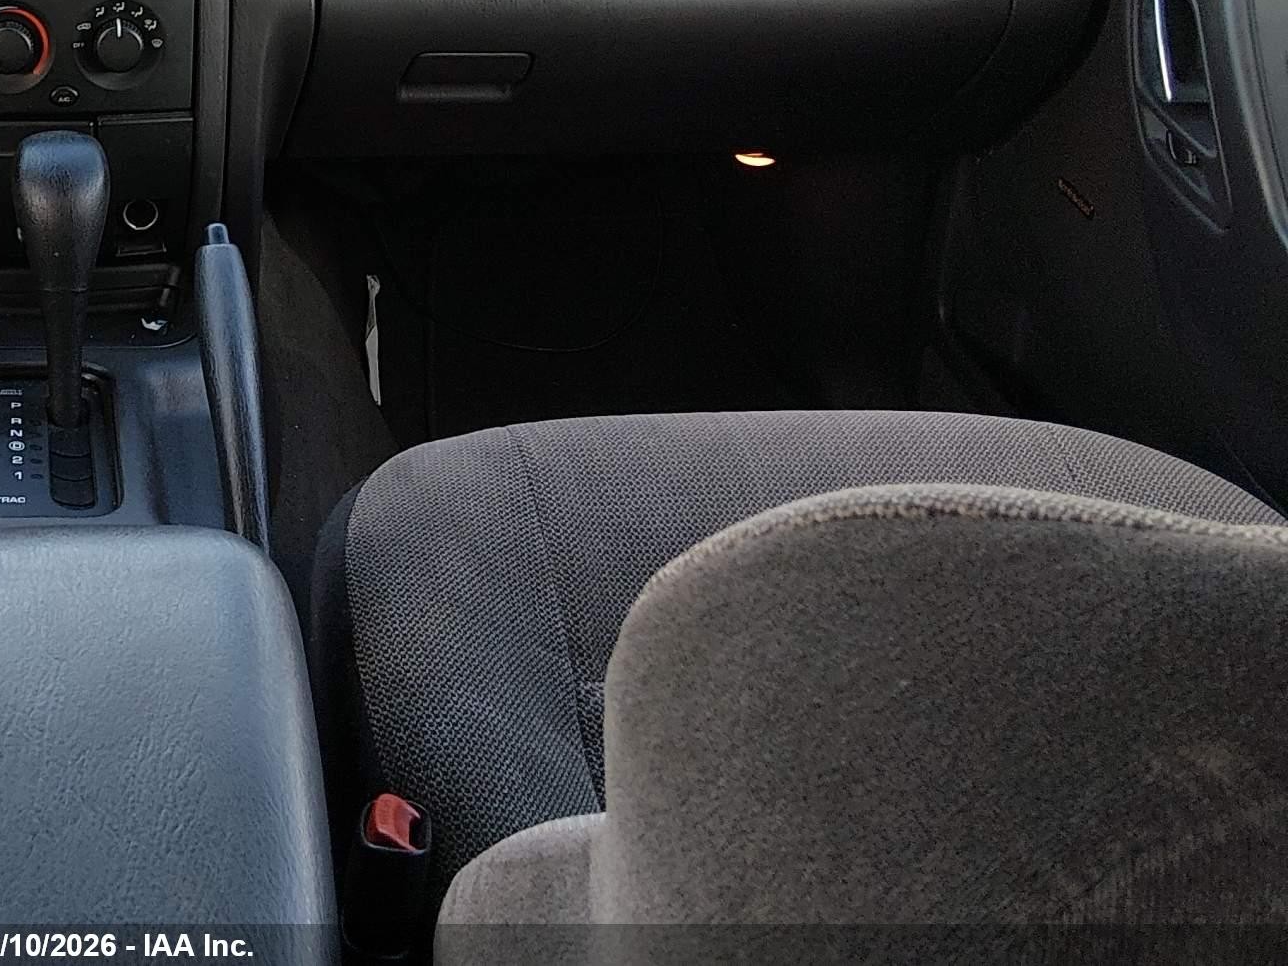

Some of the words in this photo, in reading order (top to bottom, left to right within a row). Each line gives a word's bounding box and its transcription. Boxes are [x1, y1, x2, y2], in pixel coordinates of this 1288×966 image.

[10, 417, 22, 425] R
[10, 429, 23, 437] N
[12, 455, 23, 464] 2
[14, 471, 22, 480] 1
